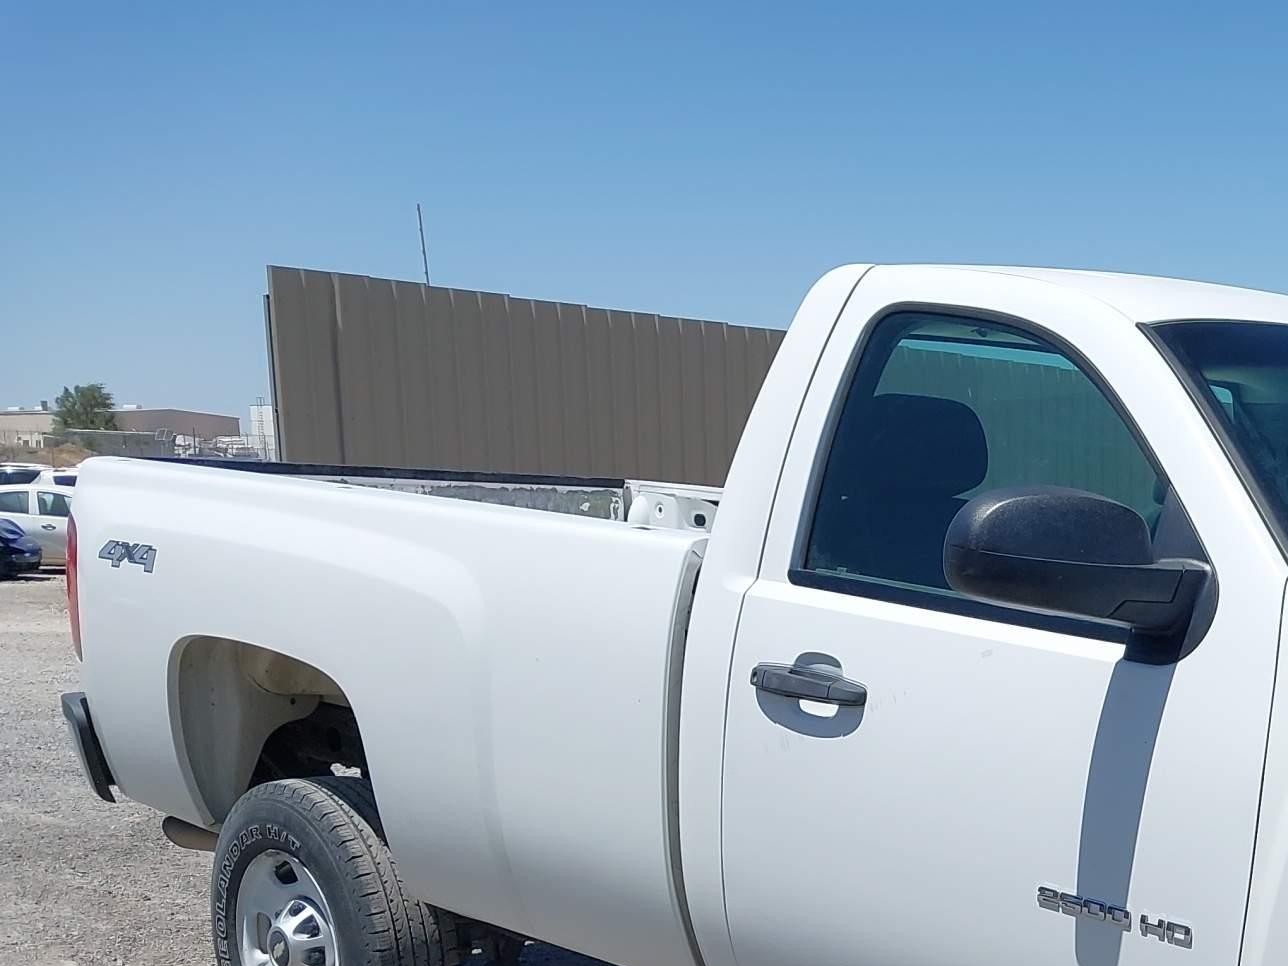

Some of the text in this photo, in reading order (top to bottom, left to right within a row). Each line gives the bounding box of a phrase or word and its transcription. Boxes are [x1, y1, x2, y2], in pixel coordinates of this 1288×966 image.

[266, 824, 302, 852] H/T
[1037, 886, 1194, 950] 2500 HD
